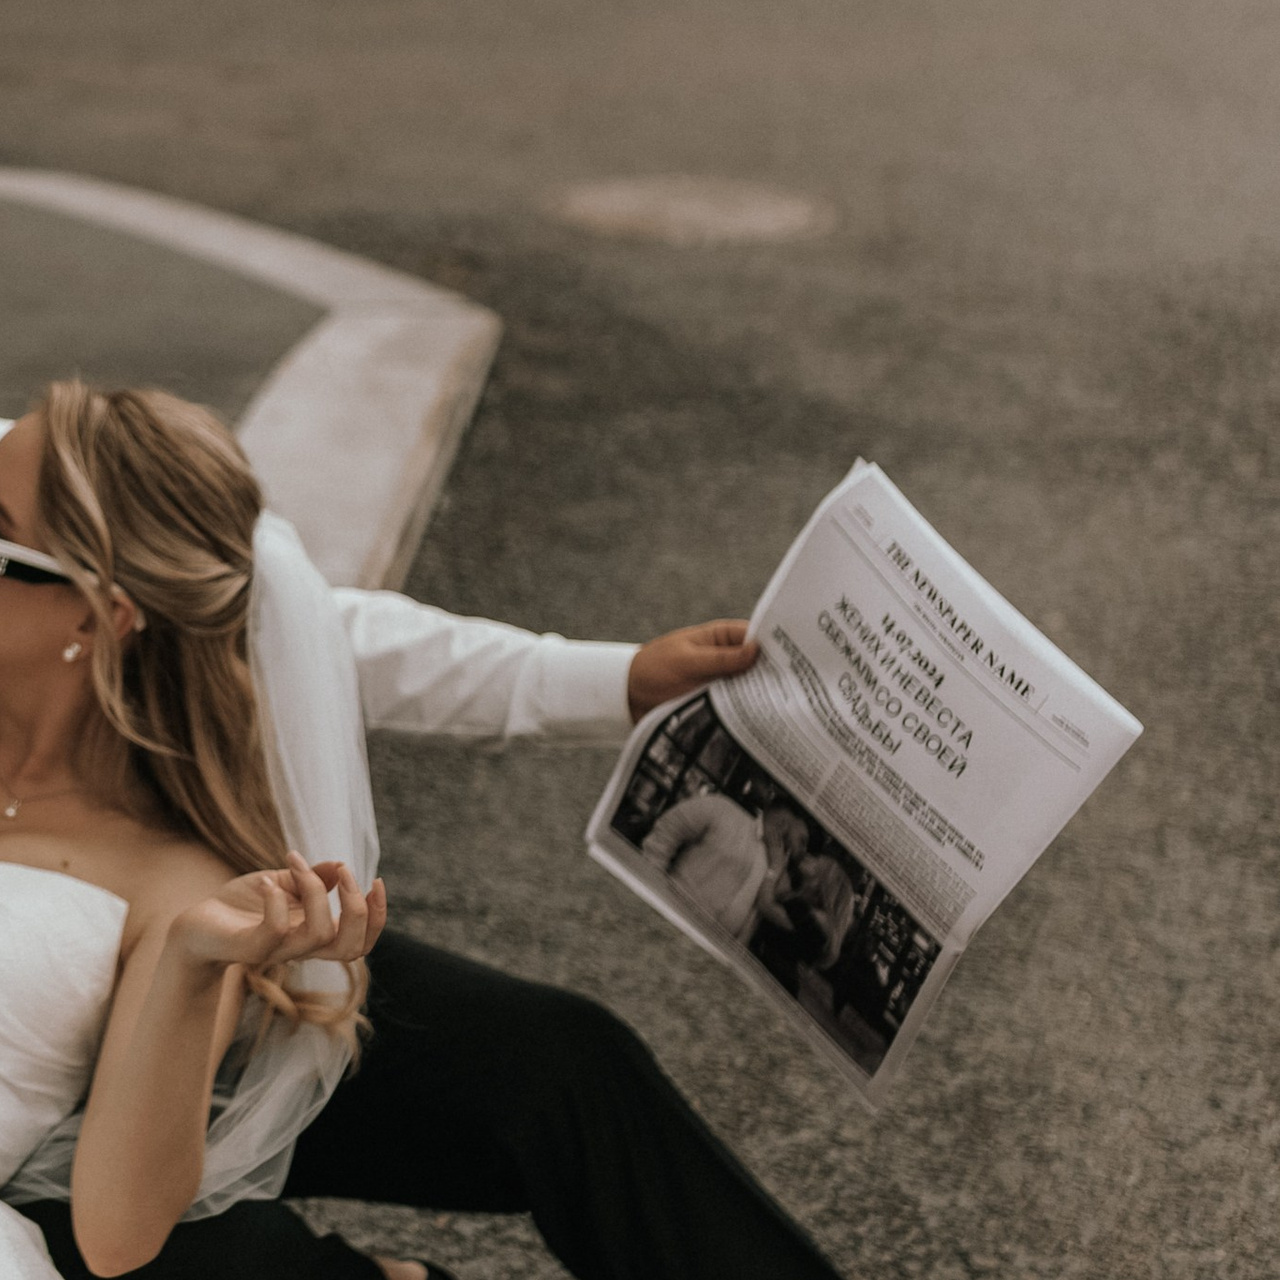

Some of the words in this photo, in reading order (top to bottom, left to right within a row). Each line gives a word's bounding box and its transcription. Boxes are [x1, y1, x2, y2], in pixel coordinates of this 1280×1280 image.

[817, 609, 878, 695] СБЕЖАЛИ
[875, 685, 903, 718] СО
[902, 711, 968, 780] СВОЕЙ
[834, 594, 884, 660] ЖЕНИХ
[880, 650, 897, 672] И
[891, 664, 974, 752] НЕВЕСТА
[912, 567, 985, 657] NEWSPAPER
[983, 648, 1035, 701] NAME
[838, 671, 902, 756] СВАДЬБЫ
